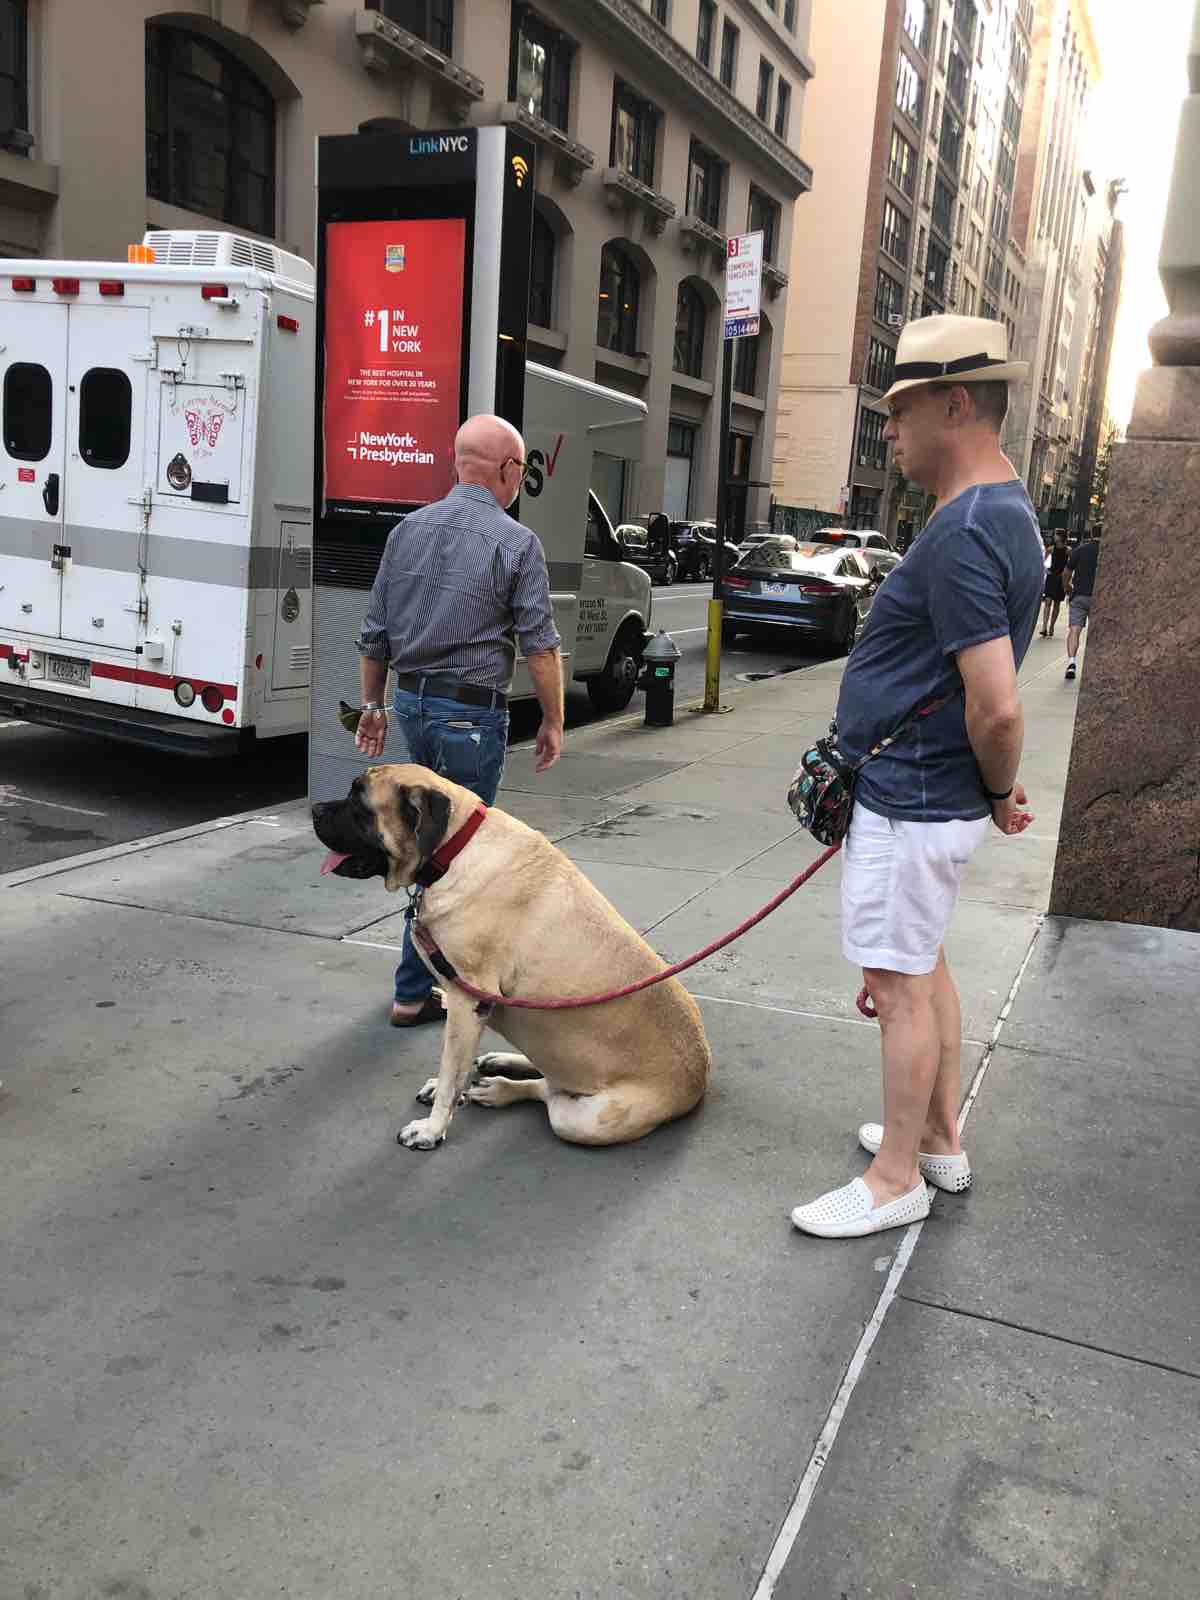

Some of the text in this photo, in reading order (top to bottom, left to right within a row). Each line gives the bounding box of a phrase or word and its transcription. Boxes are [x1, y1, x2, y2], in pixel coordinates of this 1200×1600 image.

[410, 135, 469, 153] LinkNYC
[729, 240, 737, 256] 3
[393, 310, 406, 321] IN
[393, 325, 419, 337] NEW
[392, 340, 422, 353] YORK
[360, 368, 372, 377] THE
[372, 369, 386, 377] BEST
[386, 369, 414, 378] HOSPITAL
[363, 379, 378, 387] YORK
[392, 380, 408, 388] OVER
[417, 381, 437, 389] YEARS
[360, 431, 417, 448] NewYork-
[360, 446, 435, 466] Presbyterian
